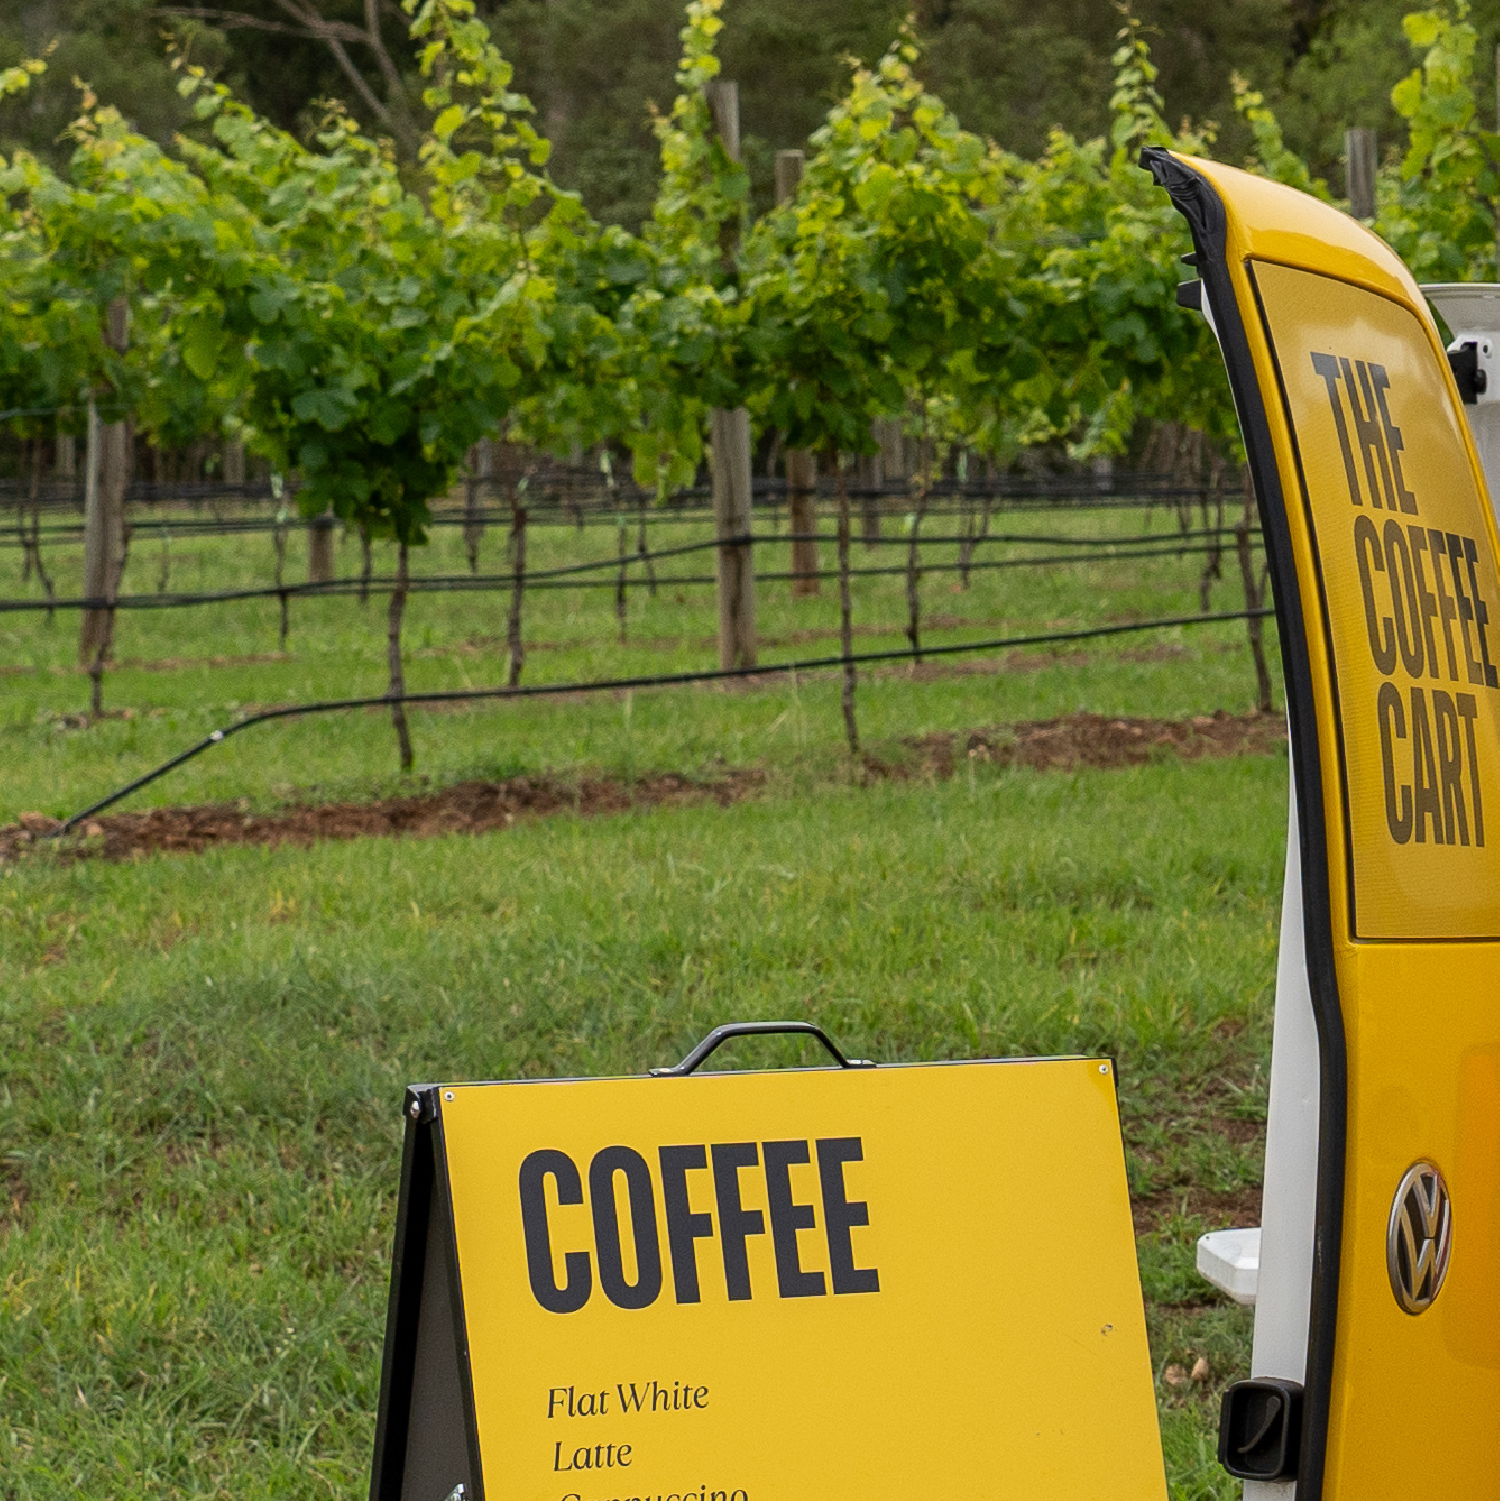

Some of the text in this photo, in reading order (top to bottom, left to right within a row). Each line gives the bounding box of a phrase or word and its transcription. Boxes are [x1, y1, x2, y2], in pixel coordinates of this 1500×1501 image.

[1311, 352, 1419, 515] THE
[1353, 514, 1499, 689] COFFEE
[1377, 682, 1486, 848] CART
[518, 1136, 881, 1315] COFFEE
[546, 1380, 709, 1419] Flat White
[552, 1440, 633, 1473] Latte
